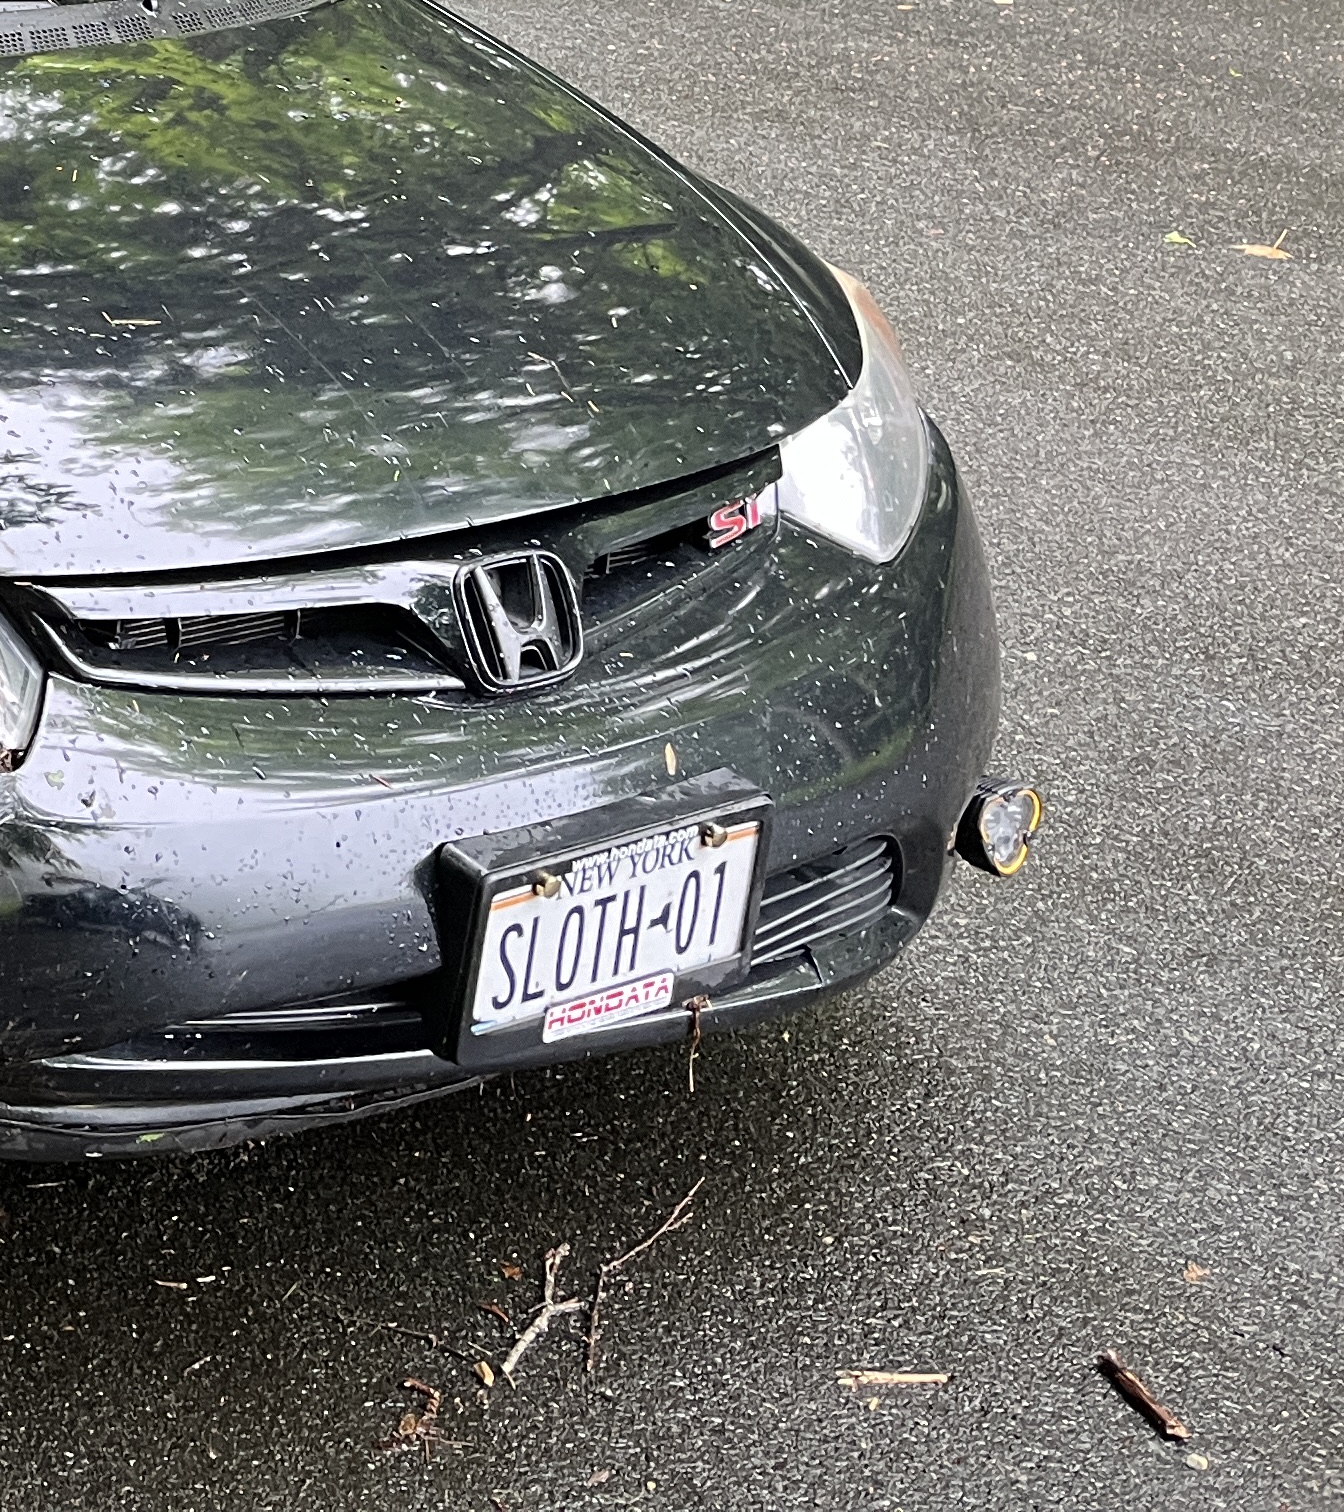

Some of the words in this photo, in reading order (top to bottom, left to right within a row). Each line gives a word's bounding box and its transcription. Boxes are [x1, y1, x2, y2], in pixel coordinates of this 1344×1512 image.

[555, 854, 621, 900] NEW
[628, 838, 696, 880] YORK
[572, 824, 700, 873] www.hondata.com
[547, 976, 670, 1030] HONDATA
